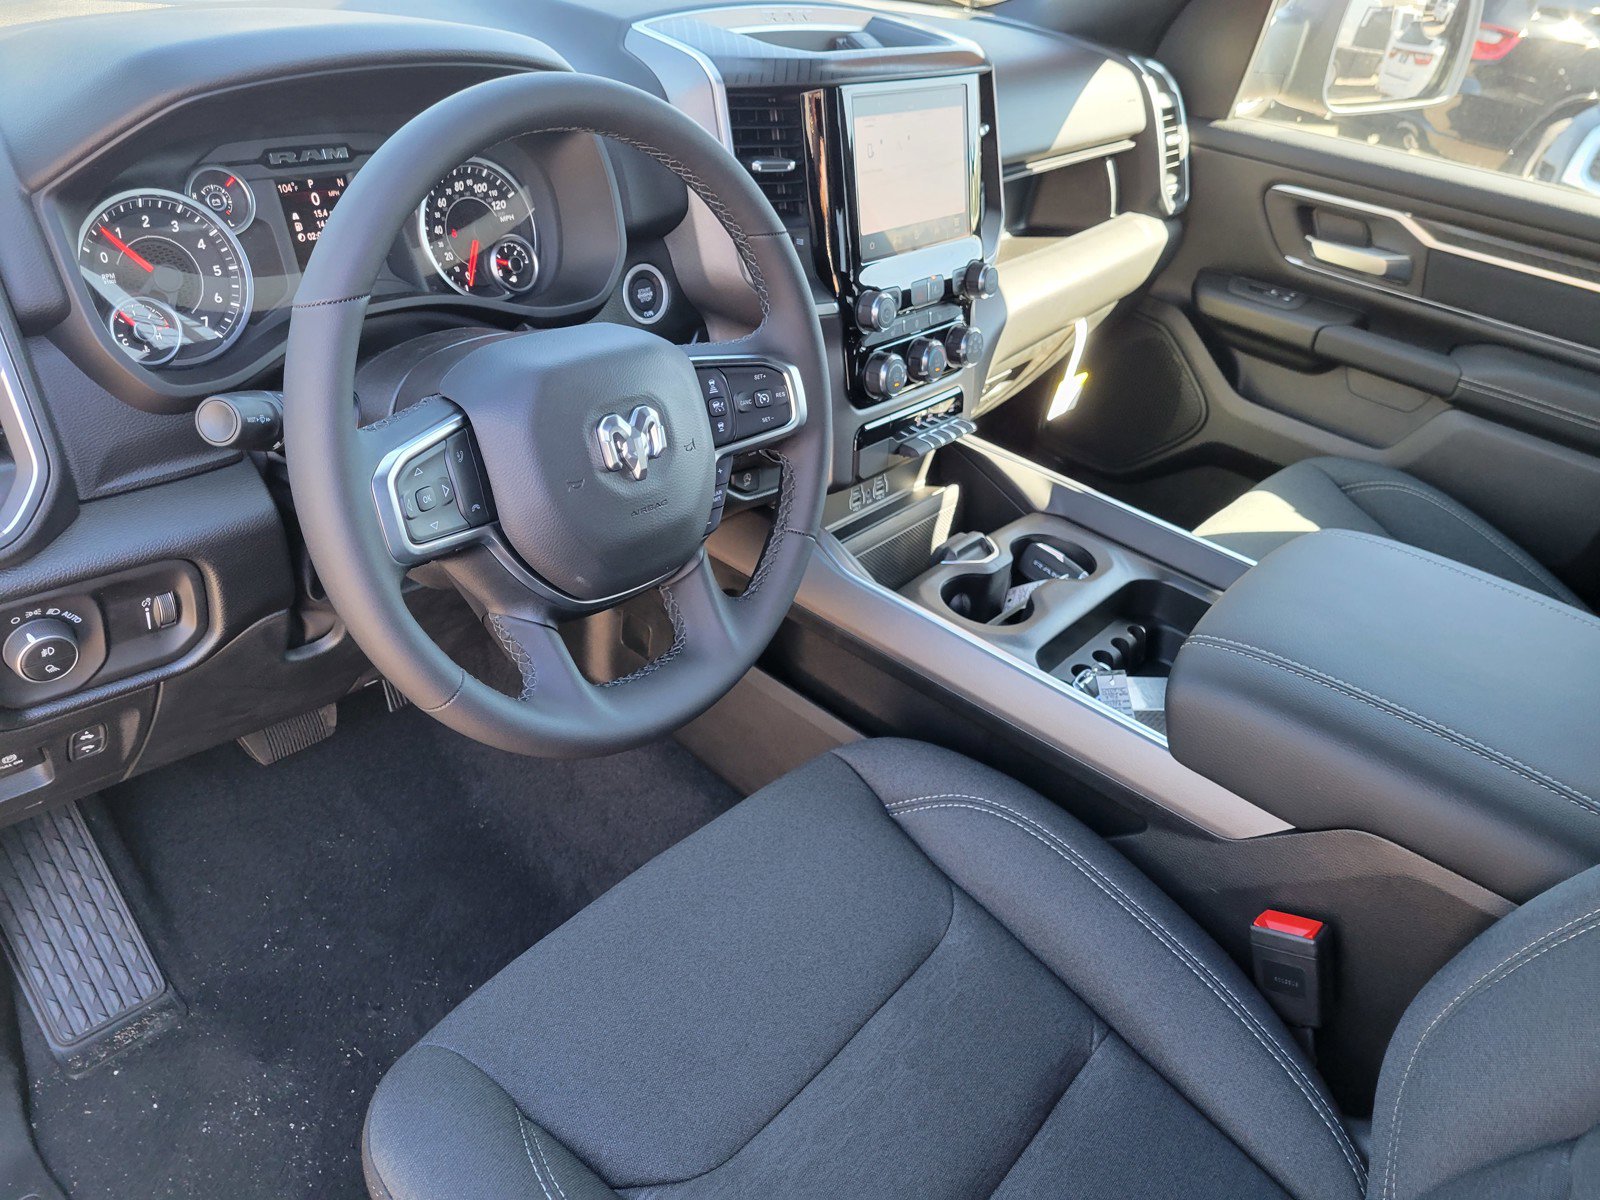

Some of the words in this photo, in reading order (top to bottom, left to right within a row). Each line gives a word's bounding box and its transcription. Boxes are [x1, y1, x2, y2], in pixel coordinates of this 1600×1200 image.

[269, 146, 349, 165] RAM
[307, 179, 313, 188] P
[336, 178, 344, 187] N
[454, 181, 464, 192] 80
[446, 188, 452, 196] 70
[473, 183, 488, 193] 100
[311, 192, 320, 206] 0
[438, 198, 447, 208] 60
[492, 200, 506, 210] 120
[314, 208, 328, 218] 15.4
[142, 215, 150, 228] 2
[171, 220, 180, 232] 3
[317, 219, 328, 229] 14
[115, 227, 122, 239] 1
[434, 226, 443, 234] 40
[197, 239, 206, 250] 4
[100, 251, 108, 263] 0
[444, 252, 454, 261] 20
[213, 265, 222, 276] 5
[102, 273, 116, 281] RPM
[214, 292, 223, 303] 6
[201, 316, 209, 327] 7
[122, 338, 129, 346] C
[754, 373, 767, 381] SET+
[423, 494, 432, 503] OK
[631, 499, 668, 517] AIRBAG
[62, 611, 82, 624] AUTO
